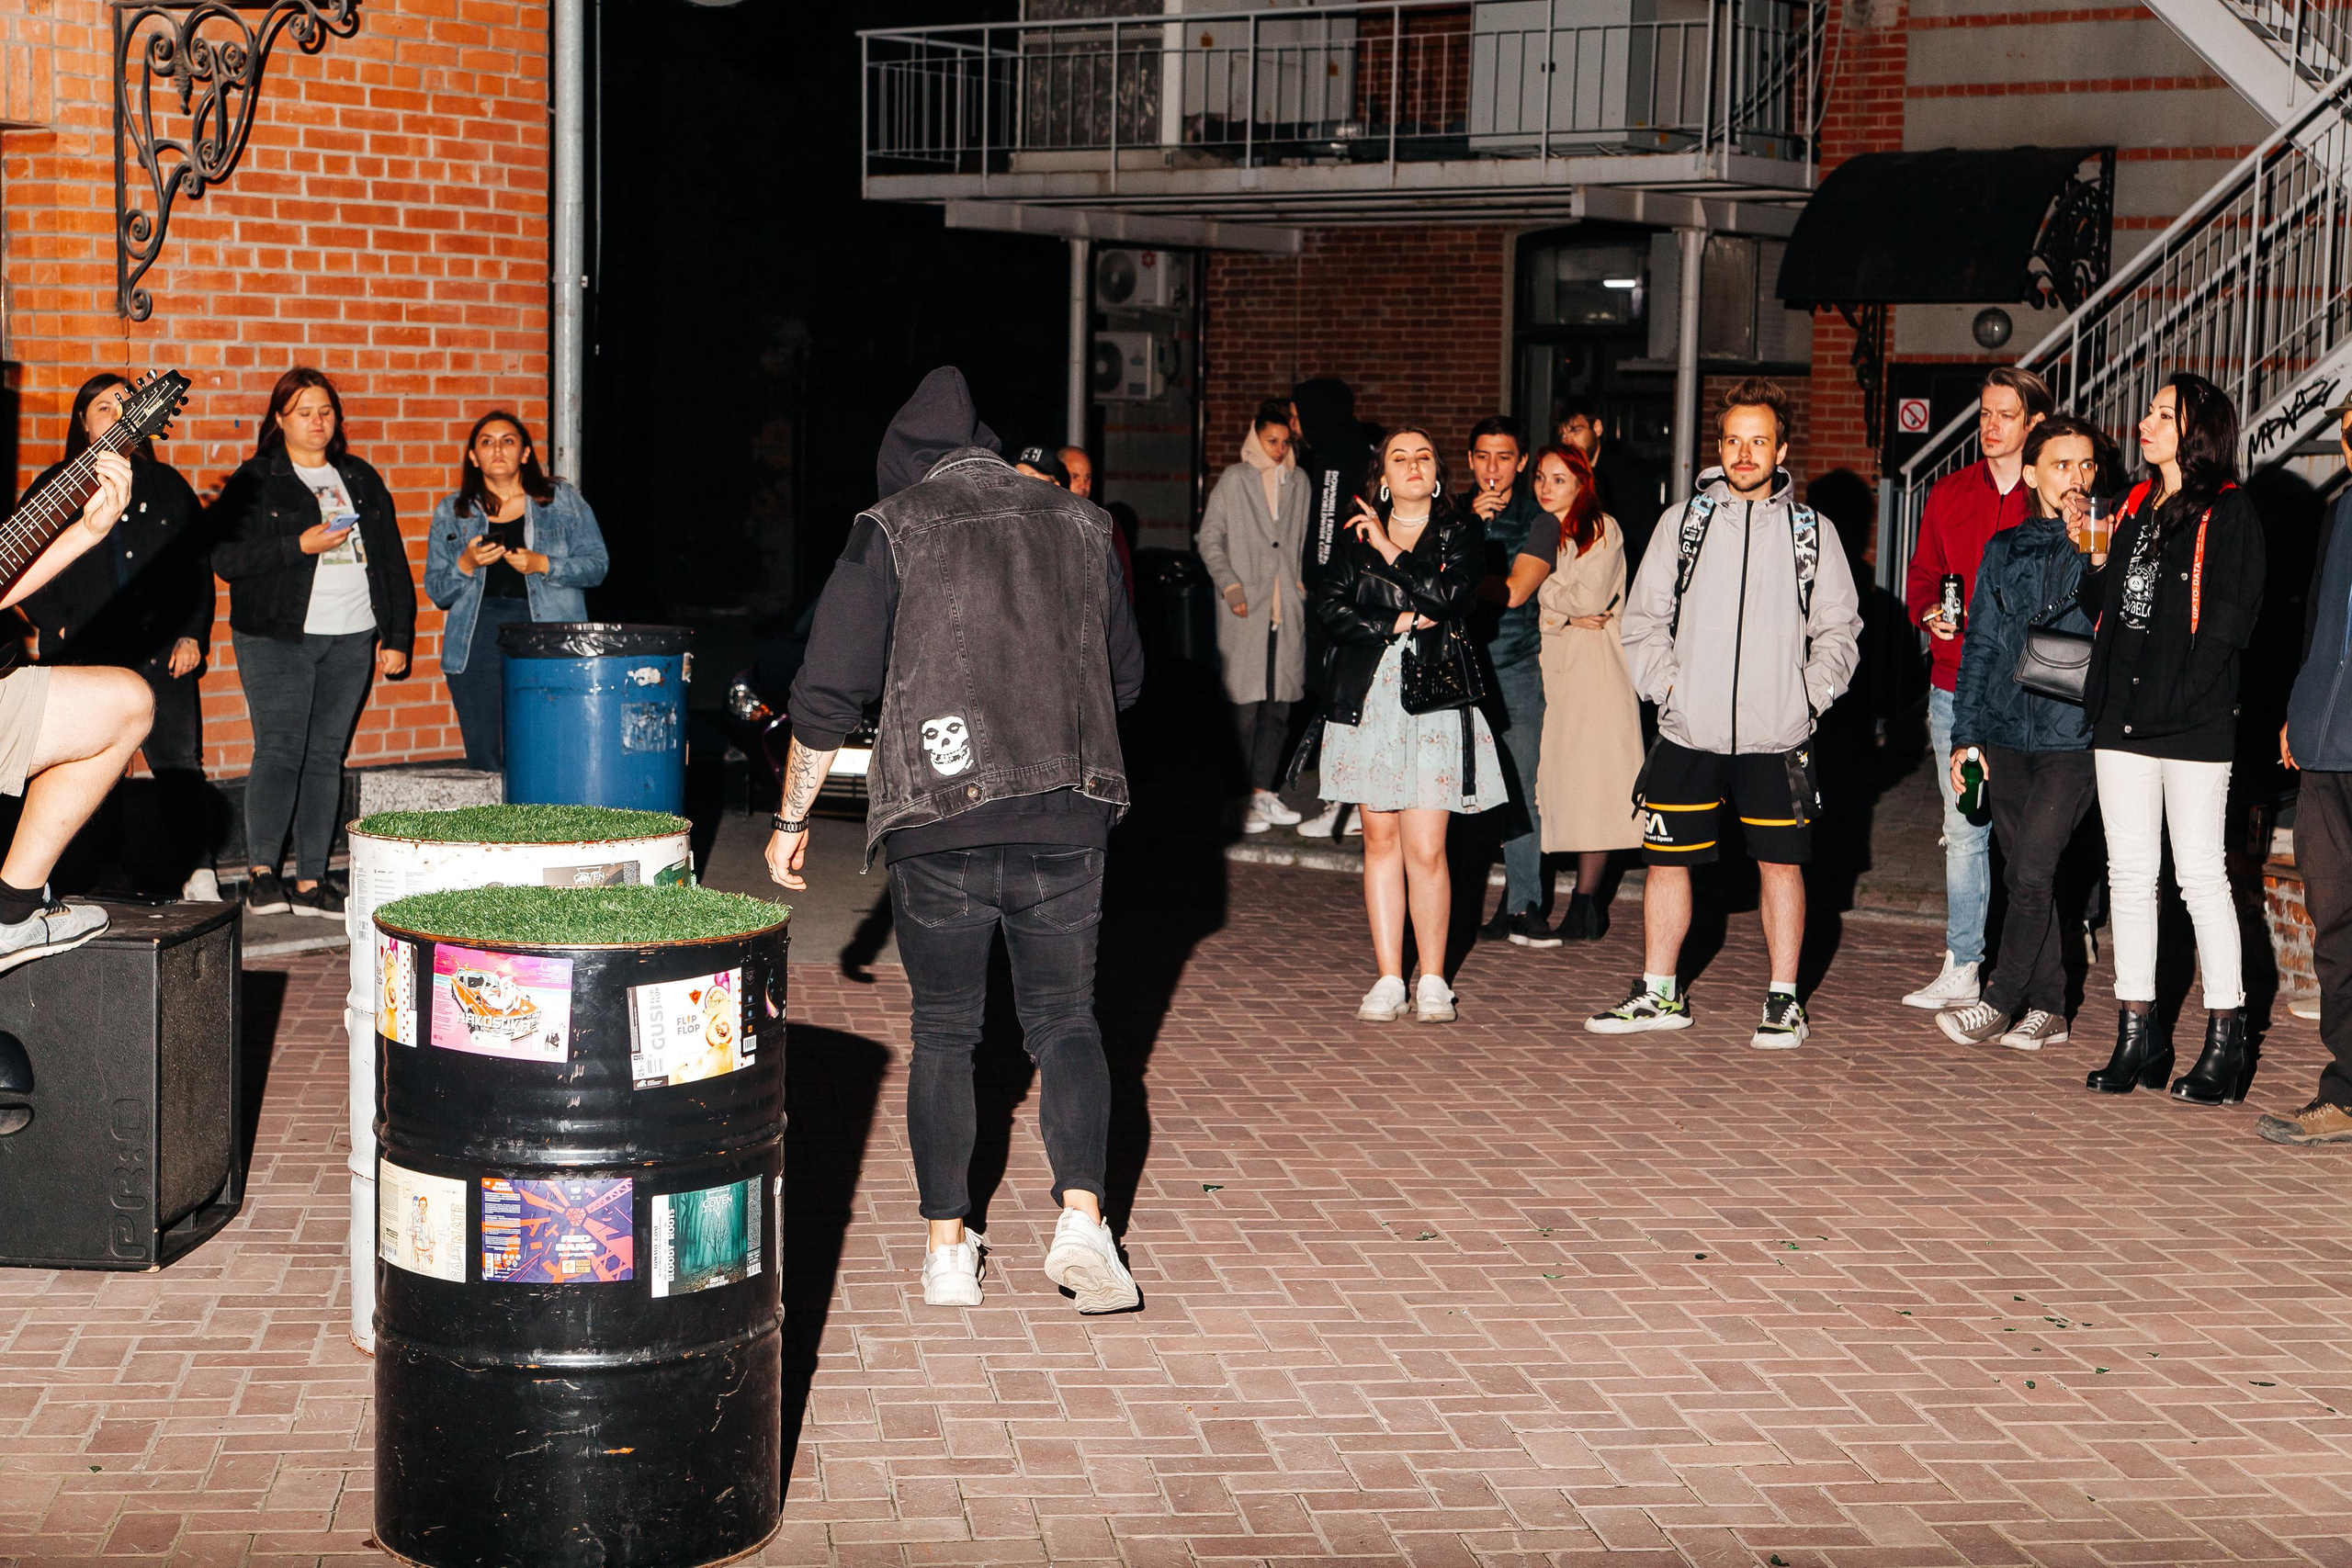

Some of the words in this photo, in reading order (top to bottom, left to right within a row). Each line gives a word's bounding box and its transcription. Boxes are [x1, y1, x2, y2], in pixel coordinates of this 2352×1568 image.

[143, 398, 164, 417] Ibanez
[2192, 562, 2201, 618] UP-TO-DATA
[677, 1015, 697, 1026] FLIP
[677, 1023, 700, 1035] FLOP
[702, 1194, 733, 1209] COVEN
[560, 1235, 592, 1243] RED
[555, 1242, 597, 1251] BANG
